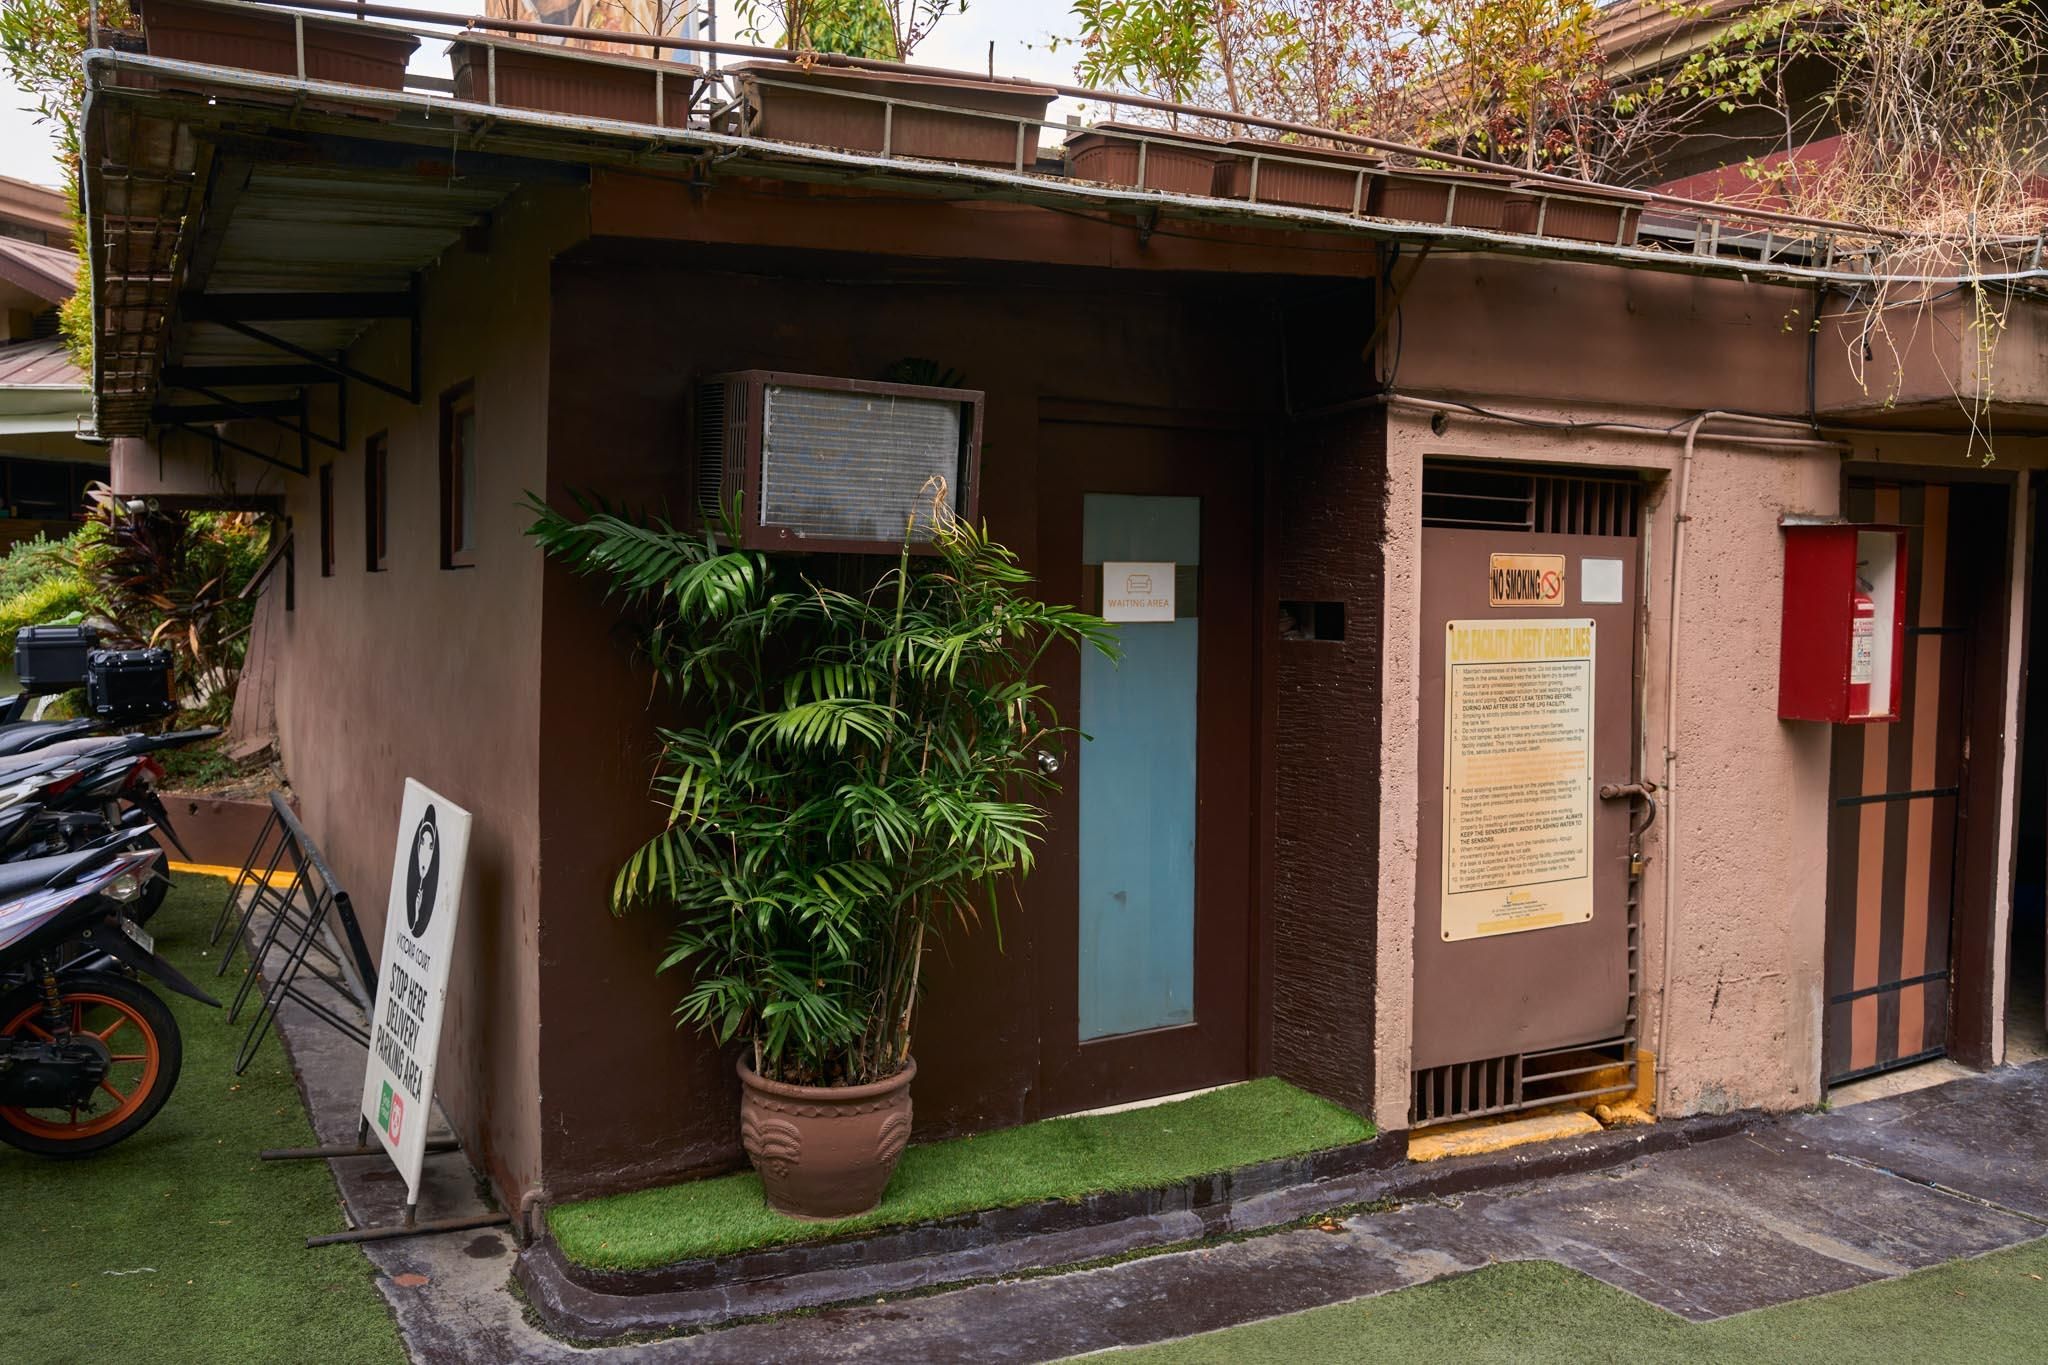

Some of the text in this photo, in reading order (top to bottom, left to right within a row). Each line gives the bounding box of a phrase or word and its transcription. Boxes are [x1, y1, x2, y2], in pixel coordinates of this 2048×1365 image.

[1492, 569, 1540, 600] NO SMOKING
[1108, 600, 1168, 608] WAITING AREA
[1545, 627, 1590, 657] GUIDELINES
[1485, 827, 1507, 835] SENSORS
[1534, 822, 1558, 830] SPLASHING
[415, 946, 431, 973] COURT
[390, 962, 428, 1022] STOP HERE
[386, 997, 420, 1055] DELIVERY
[376, 1024, 404, 1080] PARKING
[402, 1056, 423, 1104] AREA
